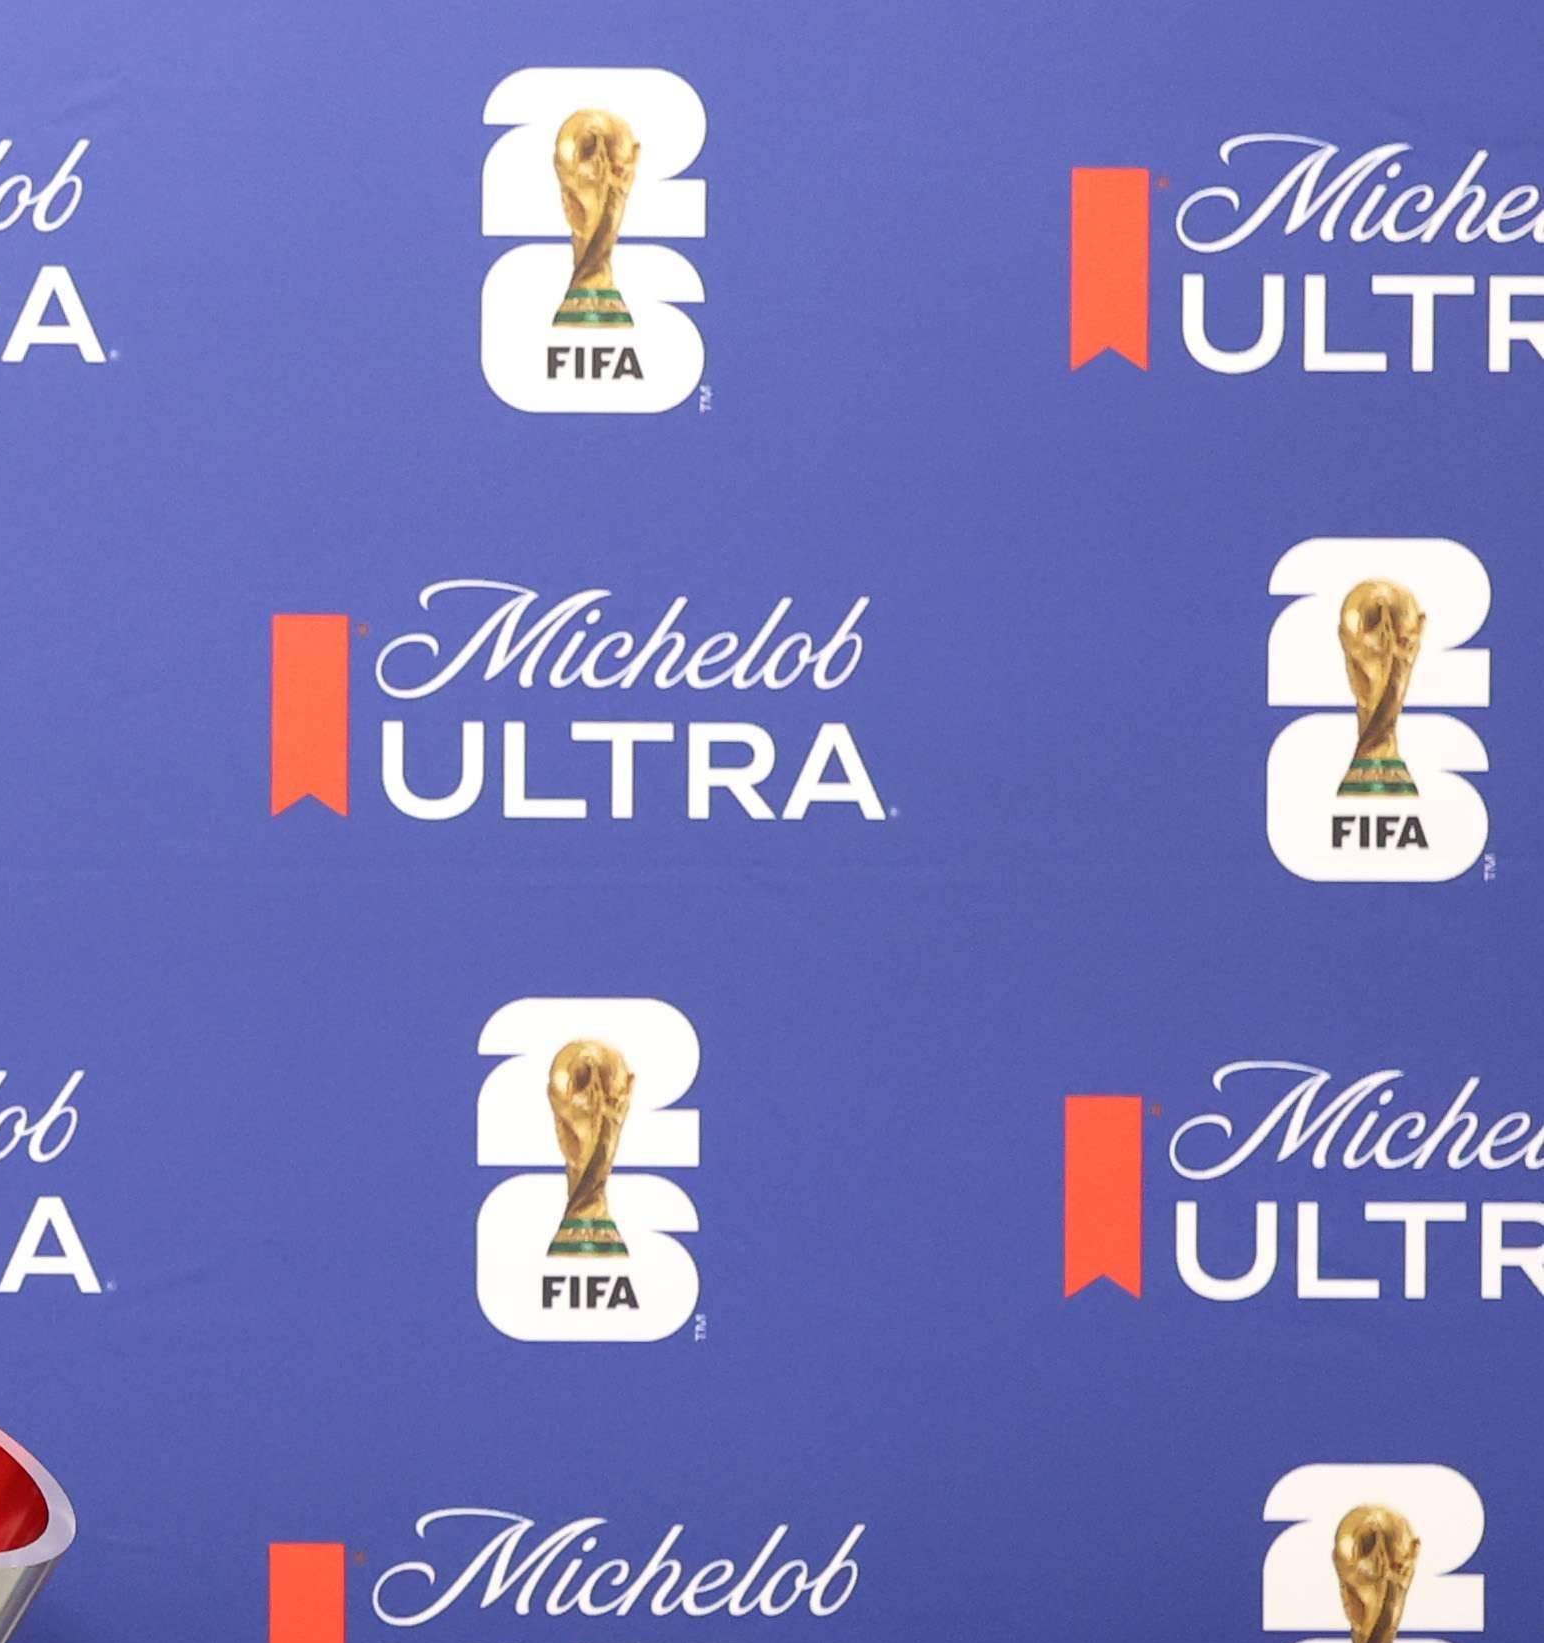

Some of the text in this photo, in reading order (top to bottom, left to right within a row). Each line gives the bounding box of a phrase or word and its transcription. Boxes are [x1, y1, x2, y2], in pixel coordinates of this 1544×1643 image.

[1175, 133, 1544, 253] Miche
[548, 347, 643, 379] FIFA
[376, 580, 863, 698] Michelob
[382, 720, 885, 820] ULTRA
[1332, 816, 1428, 848] FIFA
[1169, 1061, 1544, 1179] Miche
[543, 1276, 639, 1308] FIFA
[373, 1508, 863, 1626] Michelob
